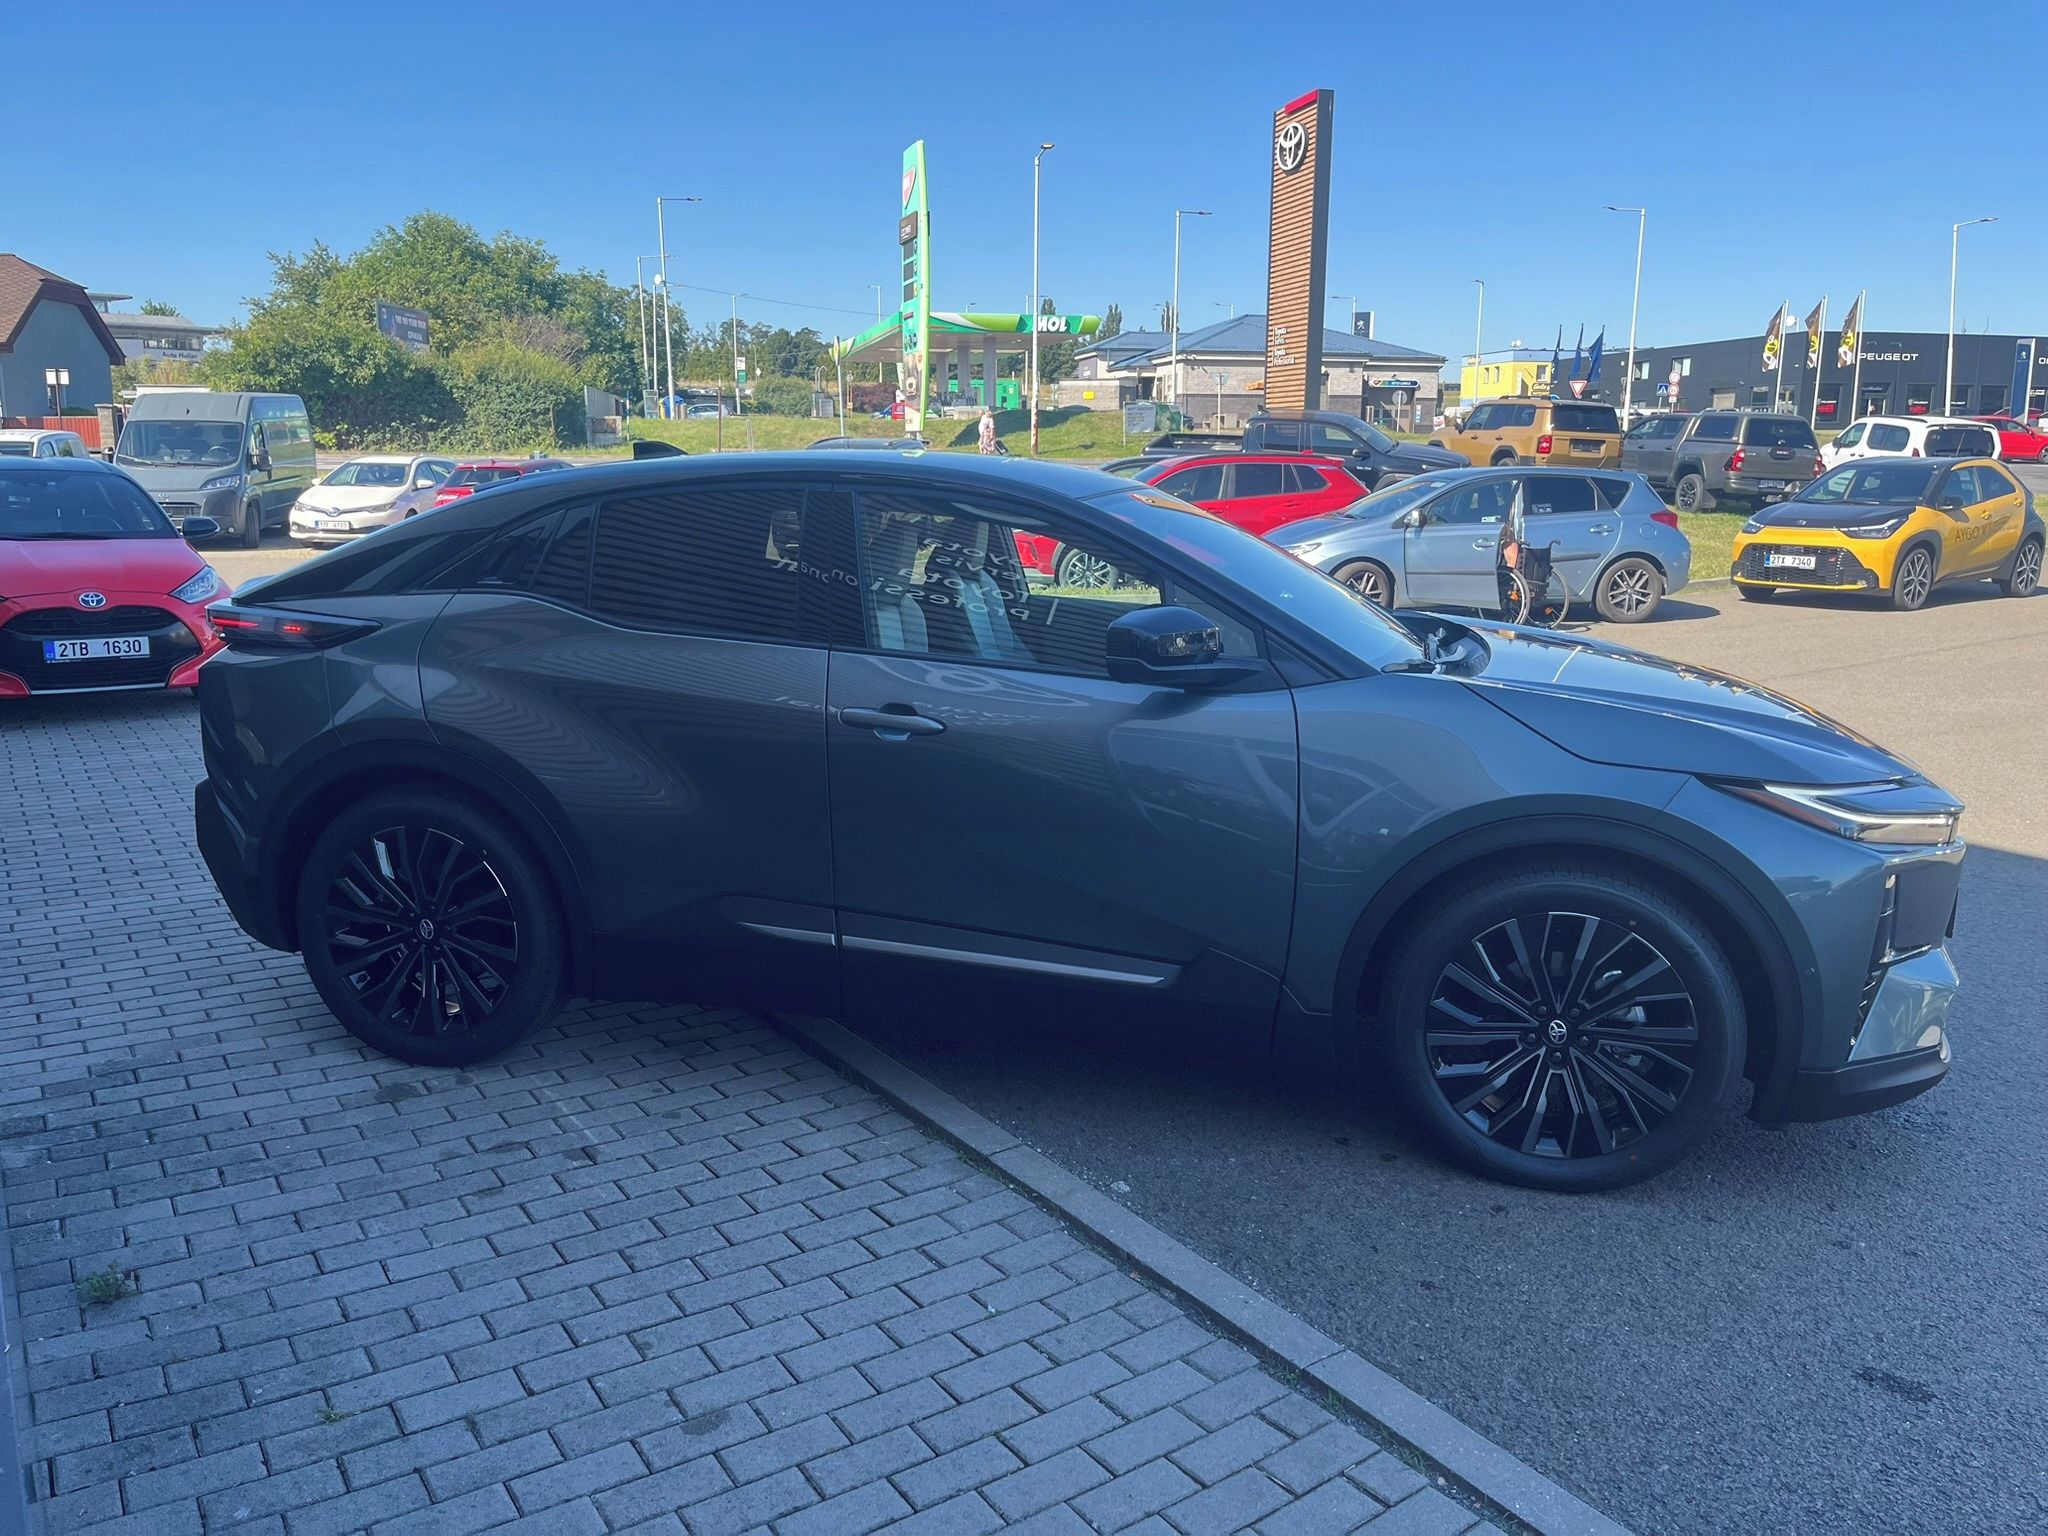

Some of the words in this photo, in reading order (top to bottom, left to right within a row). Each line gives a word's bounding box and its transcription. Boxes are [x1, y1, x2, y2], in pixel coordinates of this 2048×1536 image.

[1859, 353, 1919, 362] PEUGEOT
[1771, 556, 1786, 565] 2TX
[1791, 557, 1812, 566] 7340
[58, 642, 89, 657] 2TB
[103, 640, 142, 655] 1630
